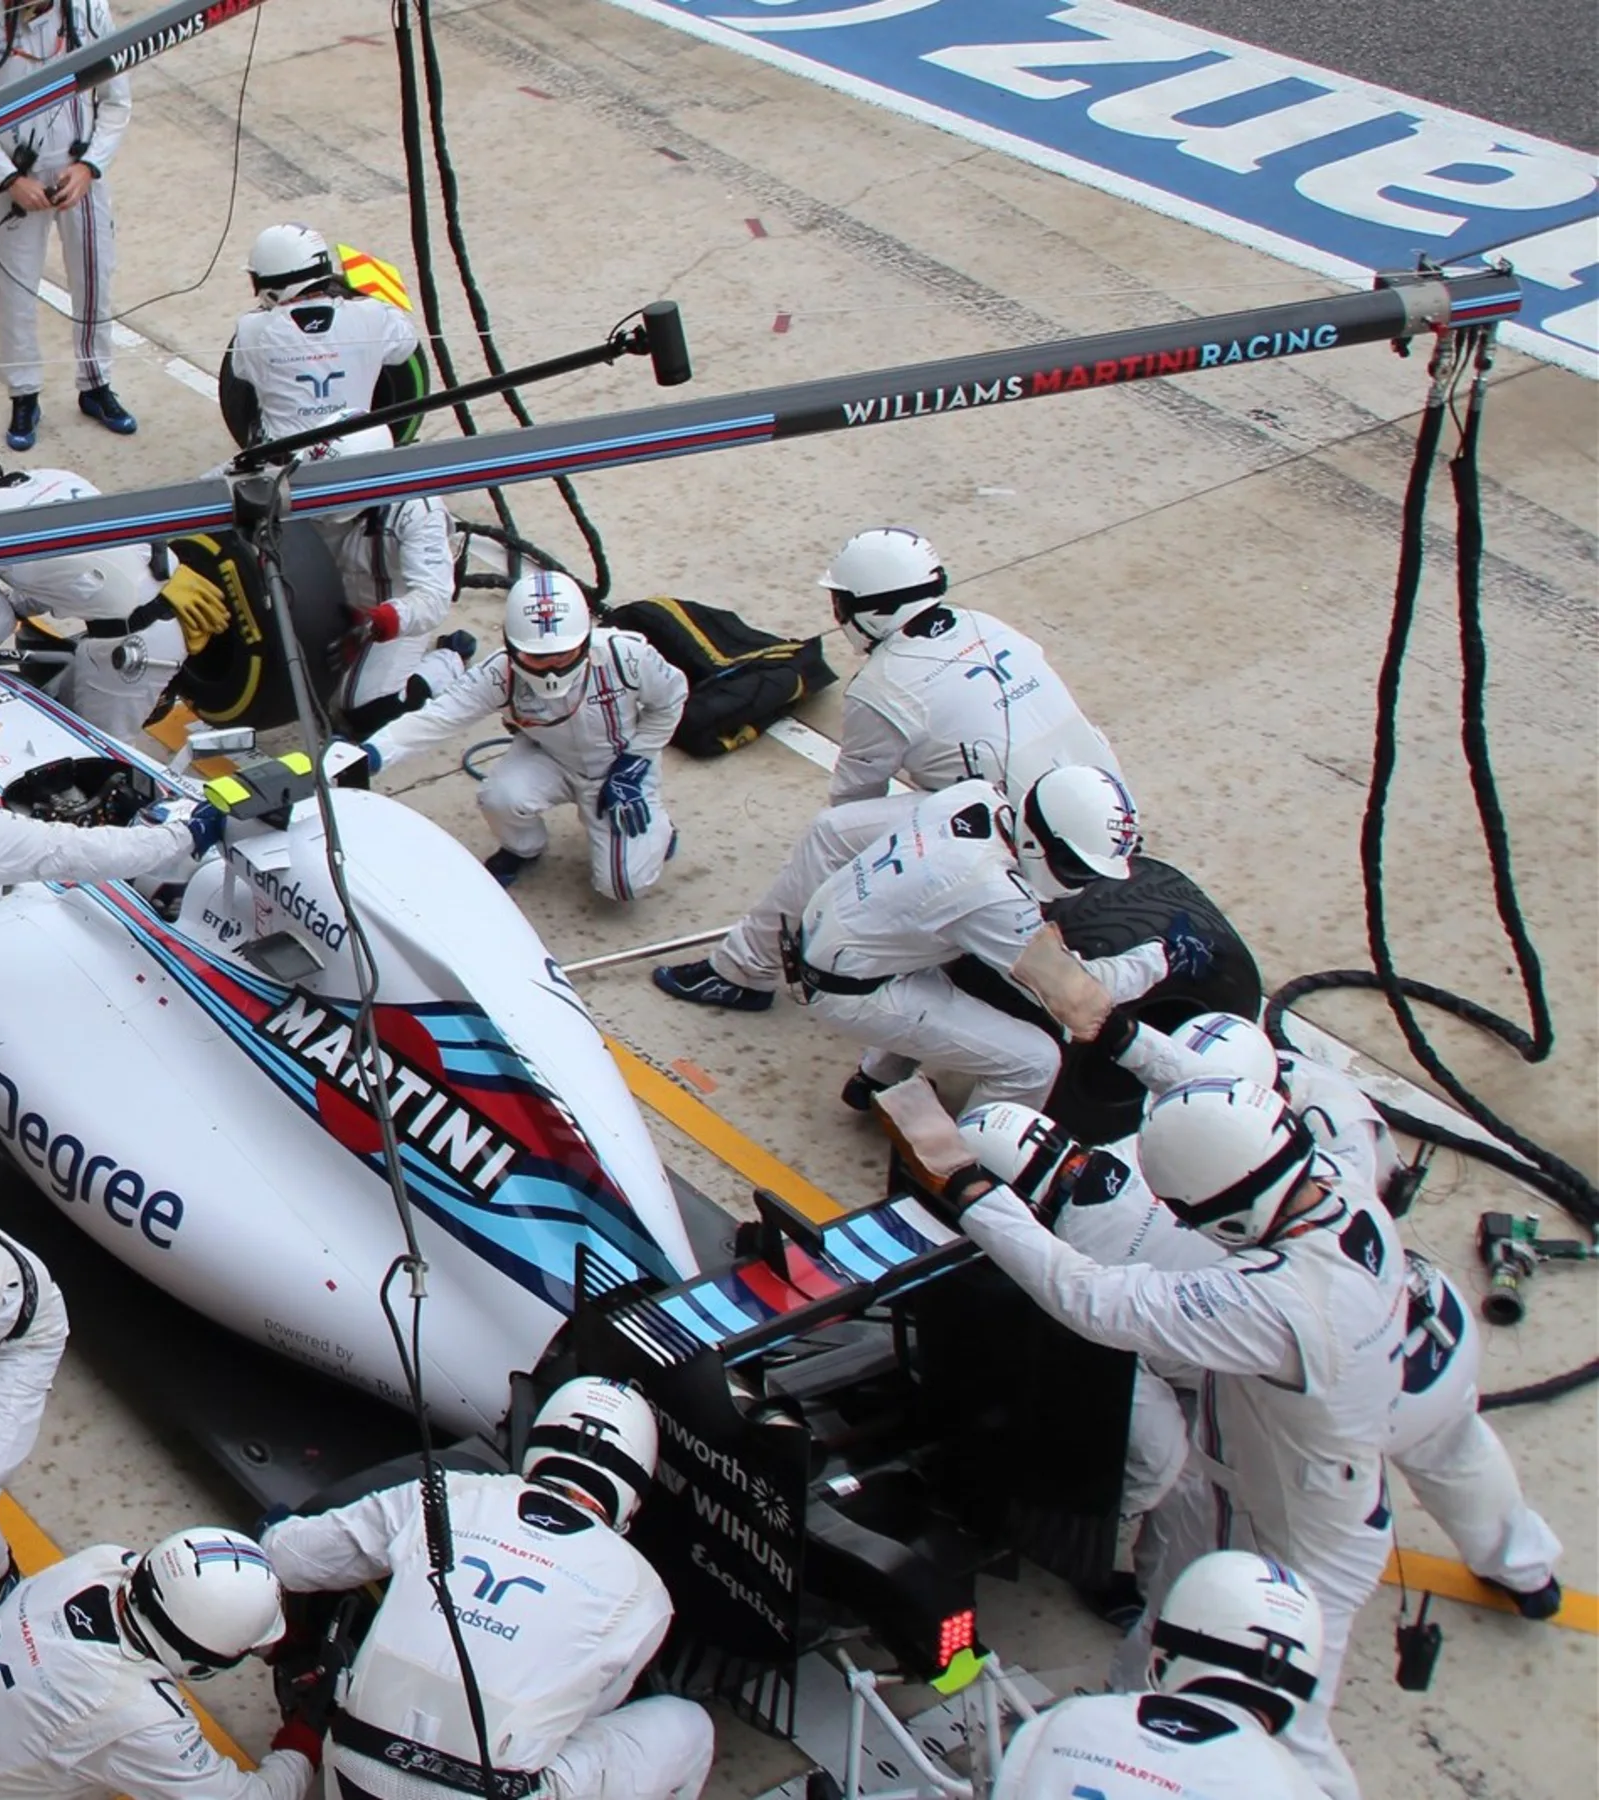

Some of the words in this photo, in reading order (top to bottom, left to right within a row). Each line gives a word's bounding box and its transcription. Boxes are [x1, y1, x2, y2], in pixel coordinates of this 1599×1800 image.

[110, 13, 205, 73] WILLIAMS
[841, 375, 1023, 426] WILLIAMS
[1031, 345, 1197, 395] MARTINI
[1200, 322, 1340, 368] RACING
[524, 602, 571, 616] MARTINI
[202, 908, 222, 929] BT
[264, 995, 518, 1192] MARTINI
[1127, 1205, 1159, 1258] WILLIAMS
[264, 1317, 331, 1354] powered
[335, 1343, 355, 1363] by
[497, 1540, 555, 1570] MARTINI
[692, 1484, 793, 1593] WIHURI
[690, 1543, 790, 1643] Esquire
[19, 1616, 41, 1667] MARTINI
[1052, 1746, 1114, 1768] WILLIAMS
[1113, 1759, 1182, 1796] MARTINI
